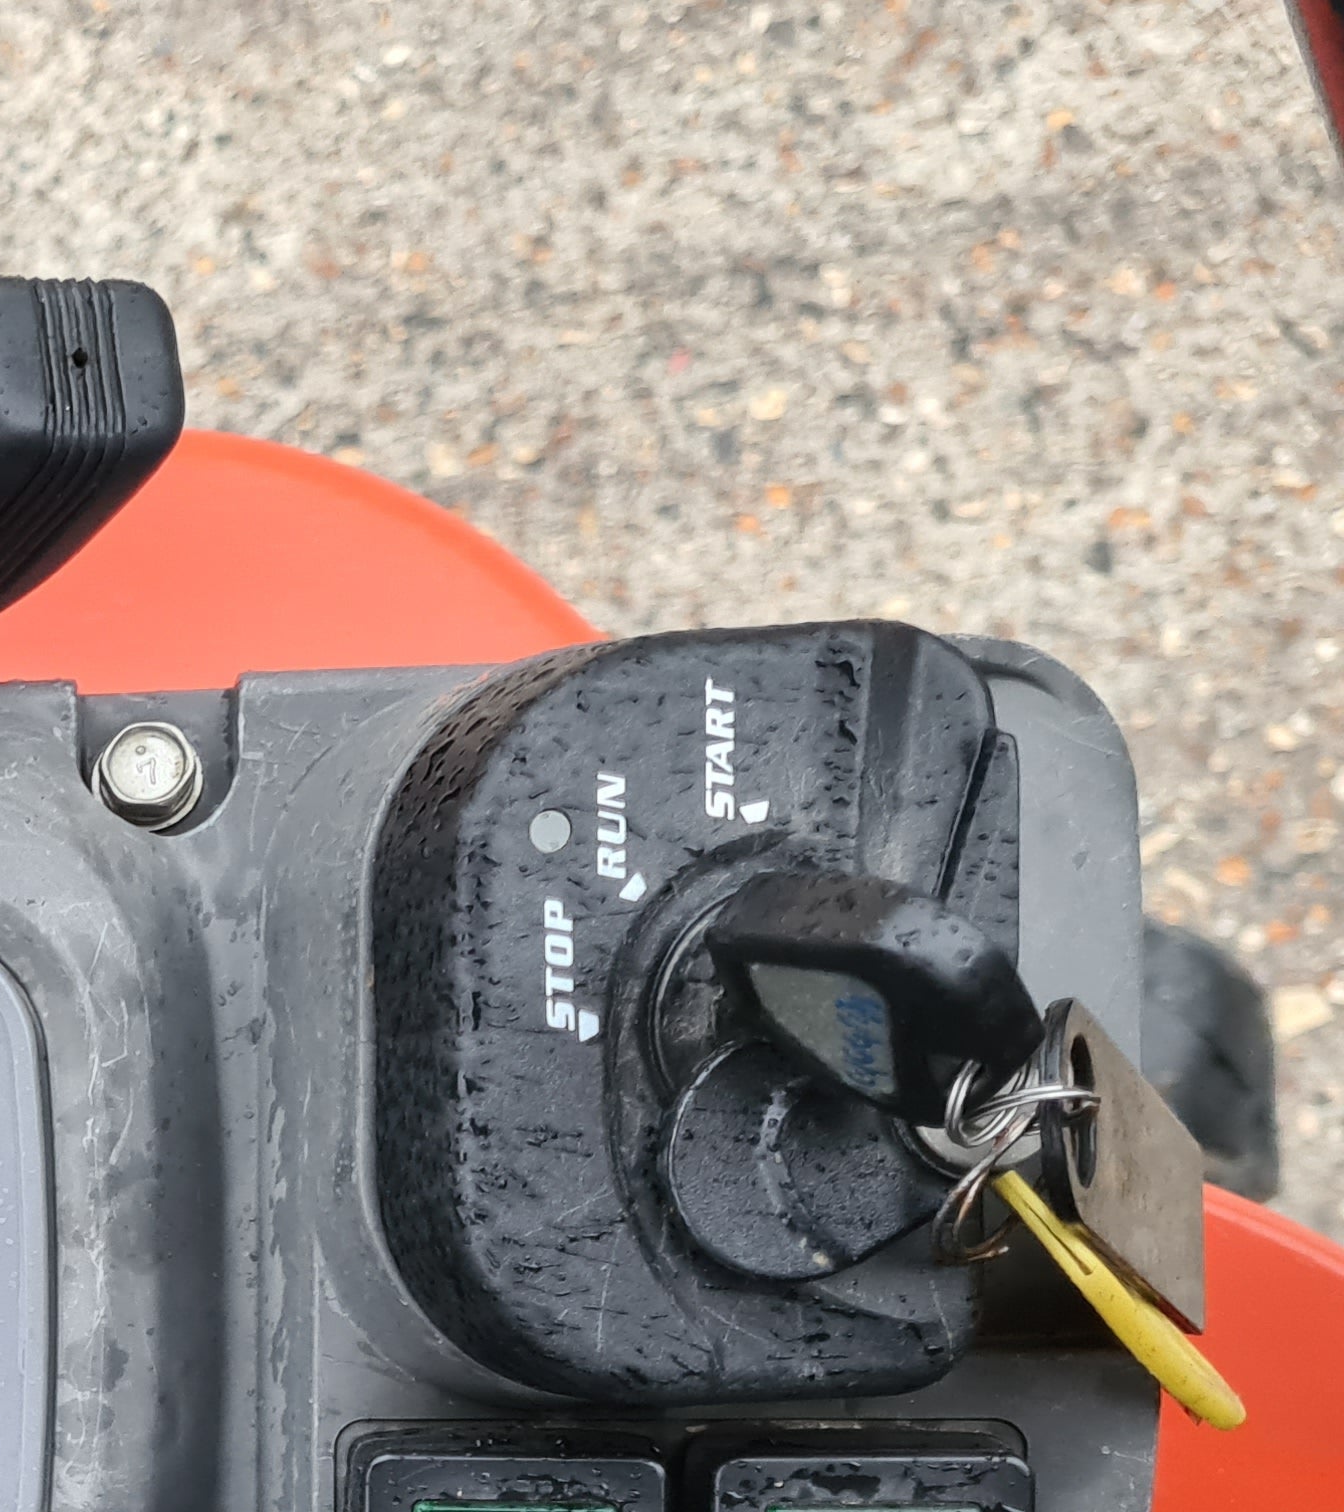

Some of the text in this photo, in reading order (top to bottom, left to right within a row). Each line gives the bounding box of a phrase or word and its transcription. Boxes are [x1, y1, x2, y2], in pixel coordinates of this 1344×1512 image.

[705, 678, 736, 820] START
[597, 772, 626, 880] RUN
[543, 899, 575, 1032] STOP
